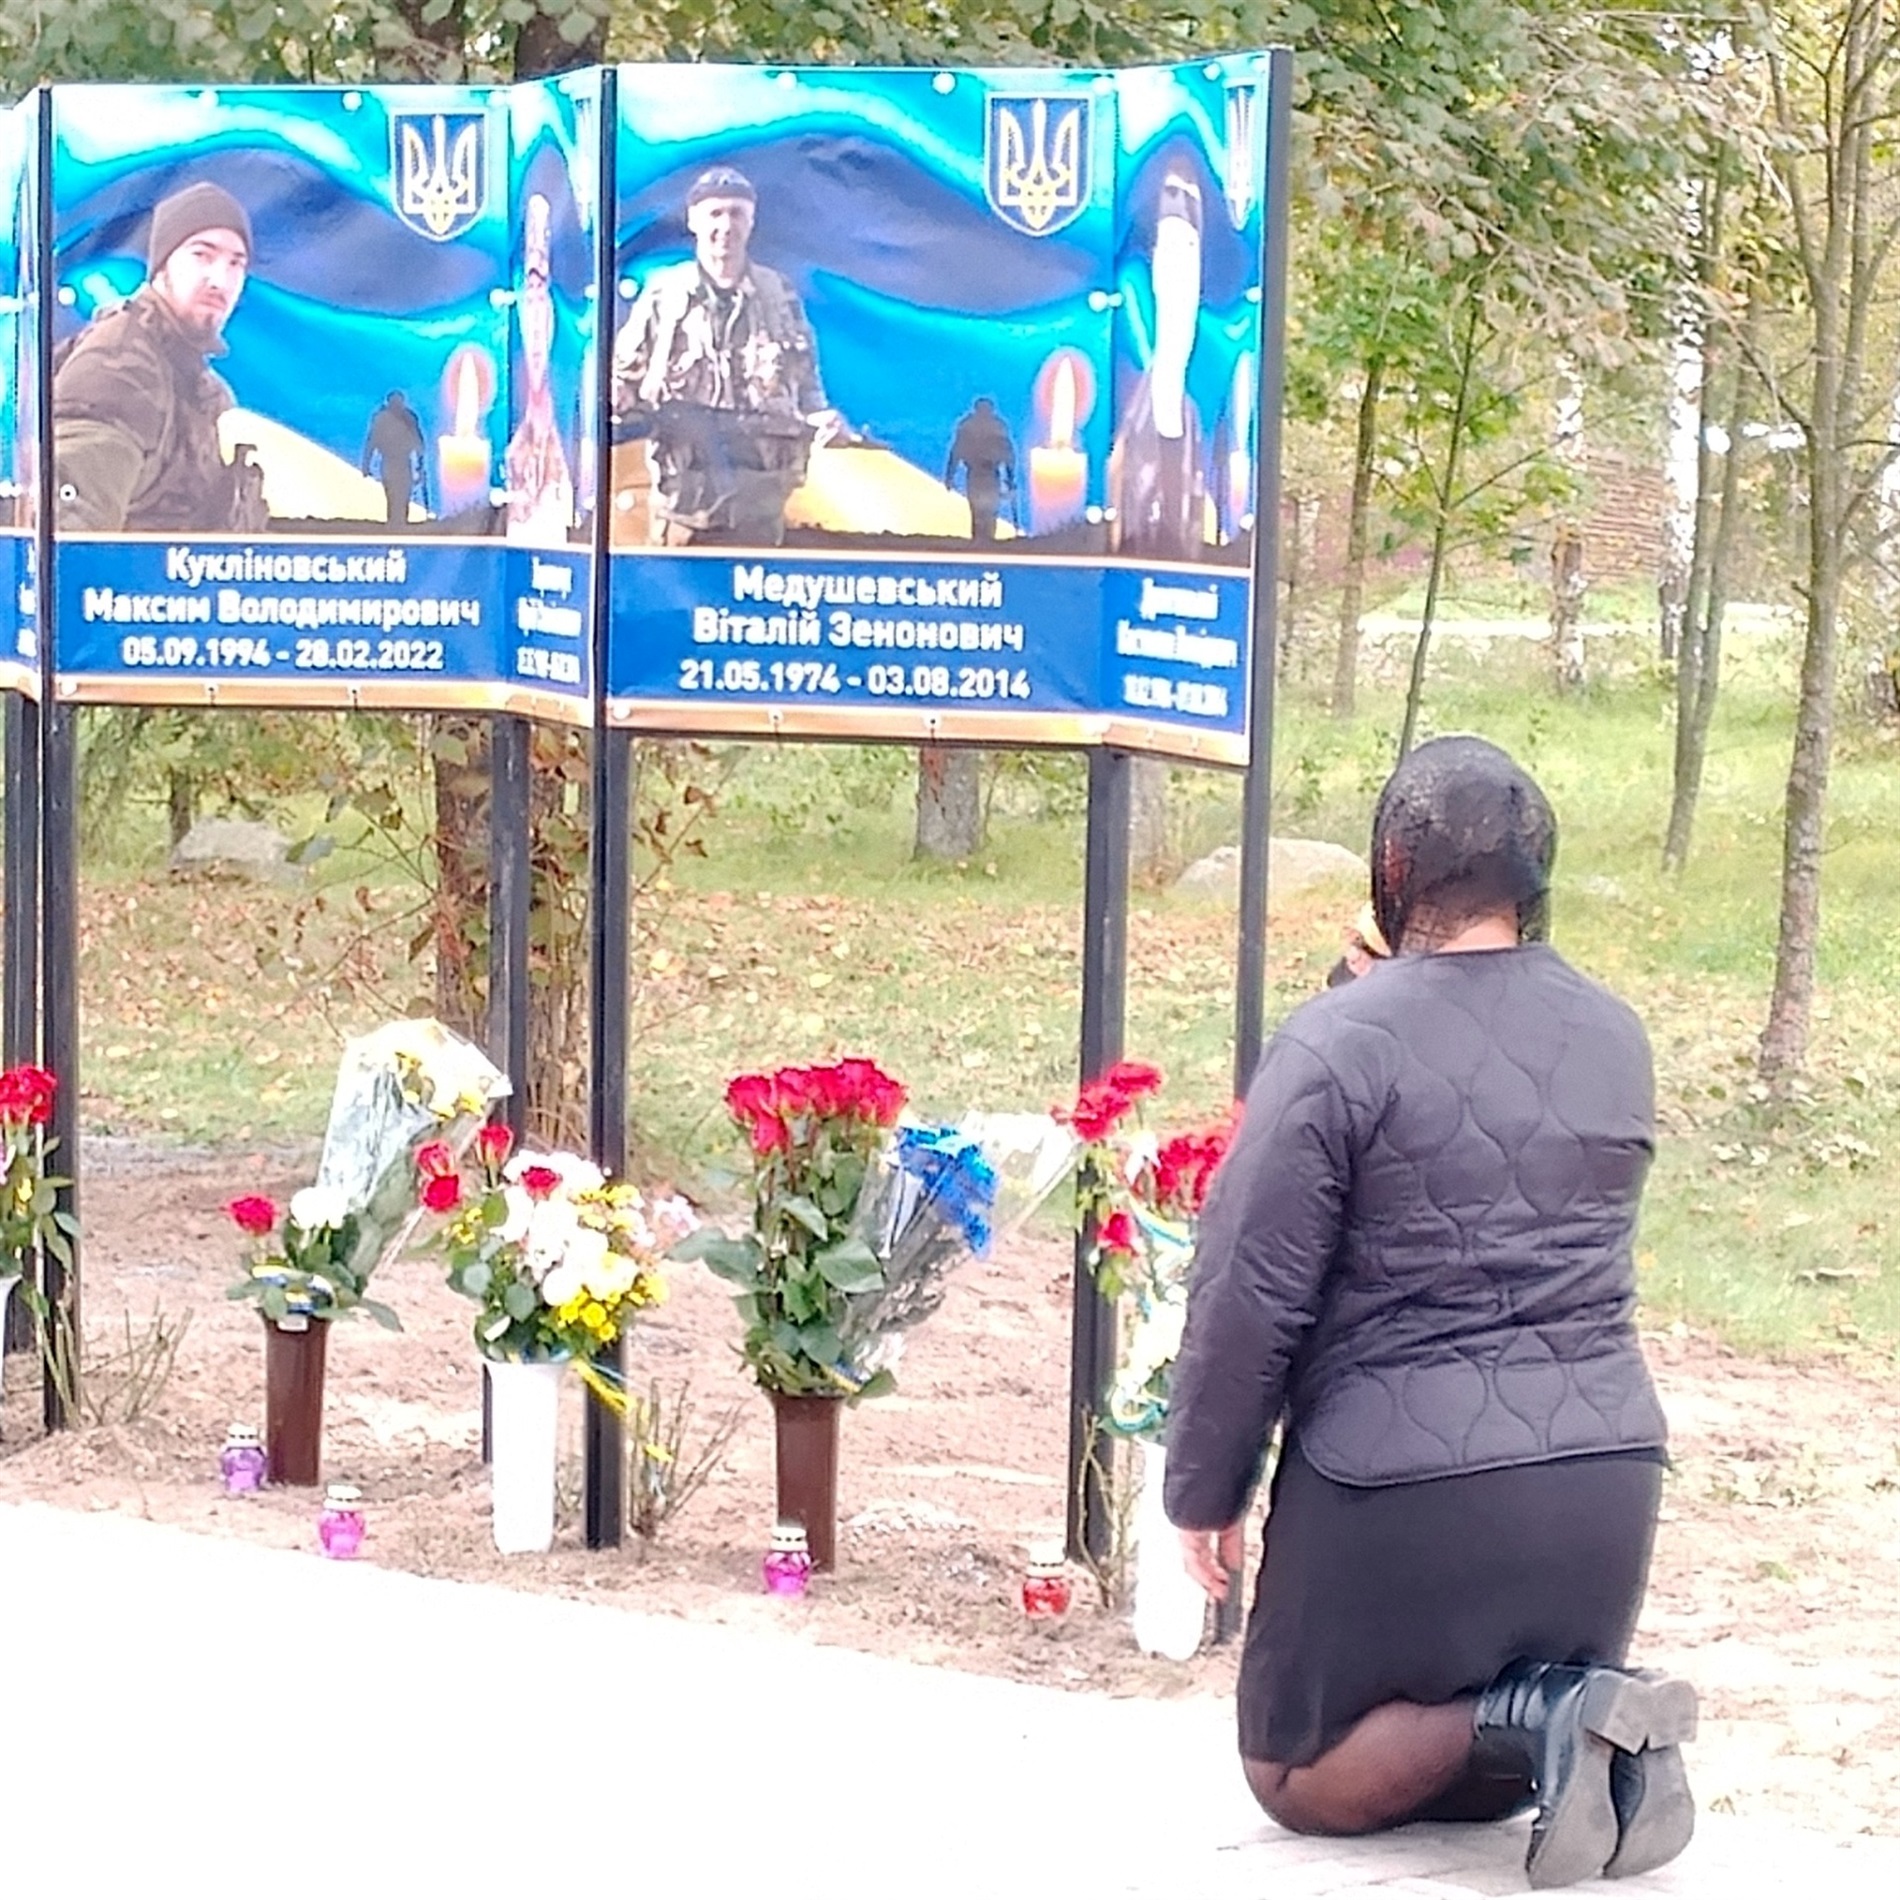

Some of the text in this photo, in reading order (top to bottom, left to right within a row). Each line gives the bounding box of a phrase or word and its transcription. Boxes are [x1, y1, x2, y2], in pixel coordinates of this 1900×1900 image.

[166, 547, 407, 588] Кукліновський
[733, 564, 1003, 610] Медушевський
[84, 587, 211, 623] Максим
[217, 589, 481, 632] Володимирович
[693, 606, 1024, 652] Віталій Зенонович
[122, 636, 271, 667] 05.09.1994
[294, 638, 444, 670] 28.02.2022
[678, 658, 841, 693] 21.05.1974
[867, 664, 1031, 699] 03.08.2014
